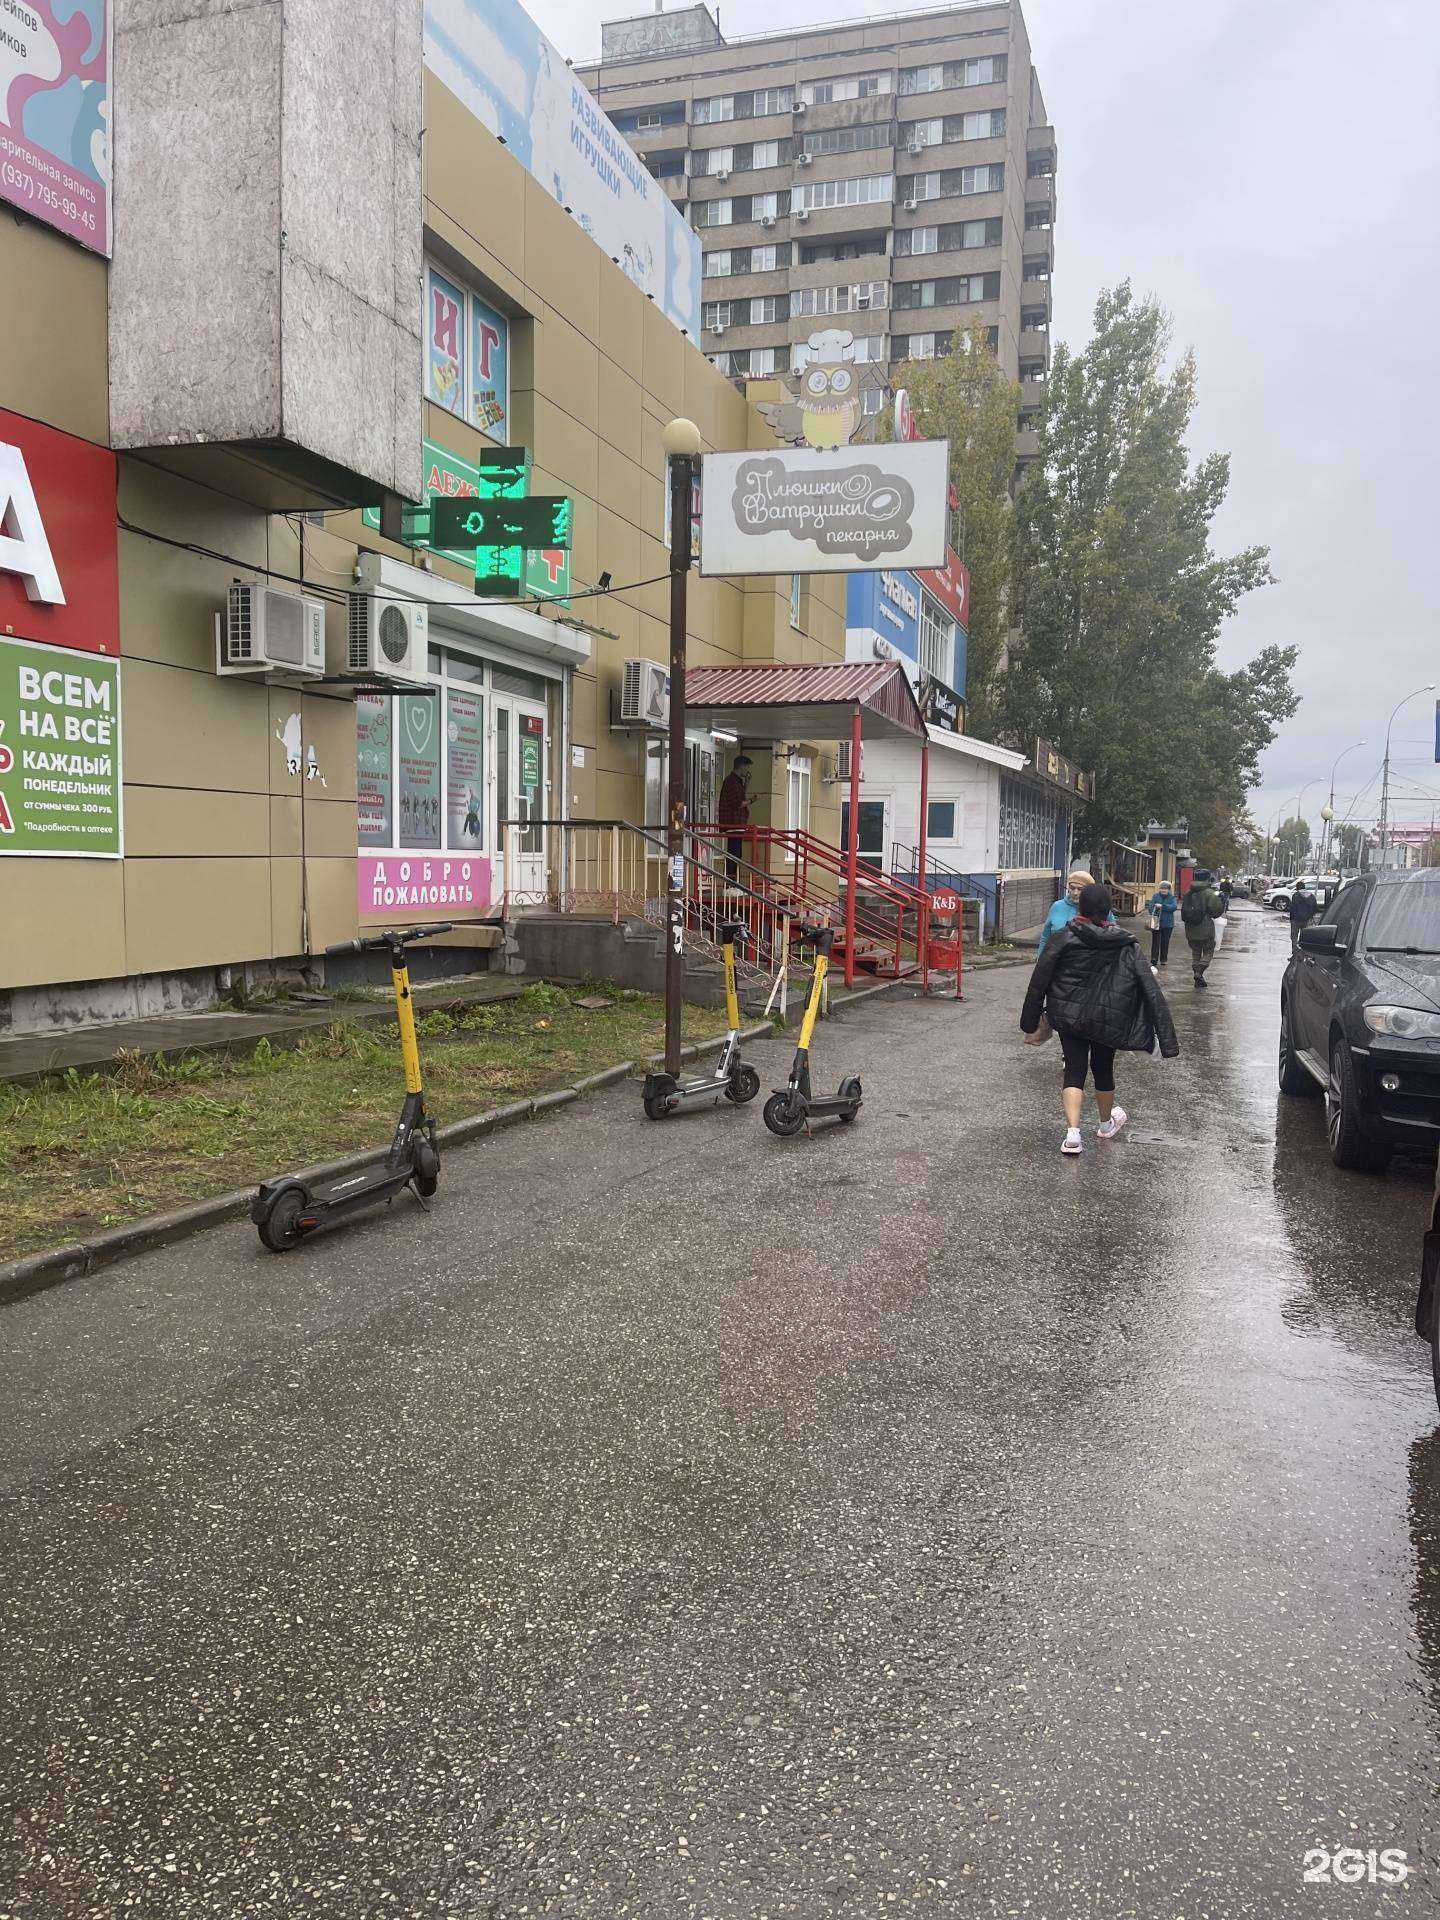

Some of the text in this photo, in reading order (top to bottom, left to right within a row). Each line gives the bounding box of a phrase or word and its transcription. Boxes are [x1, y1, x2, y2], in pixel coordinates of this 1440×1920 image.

[0, 0, 37, 31] ейпов
[571, 85, 647, 200] РАЗВИВАЮЩИЕ
[0, 136, 96, 204] арительная запись
[570, 119, 621, 199] ИГРУШКИ
[2, 161, 96, 231] (937) 795-99-45
[746, 470, 843, 500] Плюшки
[742, 494, 866, 529] Ватрушки
[826, 528, 900, 550] пекарня
[18, 665, 111, 712] ВСЕМ
[19, 709, 59, 739] НА
[22, 750, 112, 777] КАЖДЫЙ
[23, 778, 112, 796] ПОНЕДЕЛЬНИК
[24, 801, 34, 809] ОТ
[34, 802, 62, 811] СУММЫ
[62, 804, 81, 812] ЧЕКА
[82, 803, 98, 813] 300
[373, 861, 472, 886] ДОБРО
[372, 885, 473, 906] ПОЖАЛОВАТЬ
[932, 895, 956, 910] К&Б
